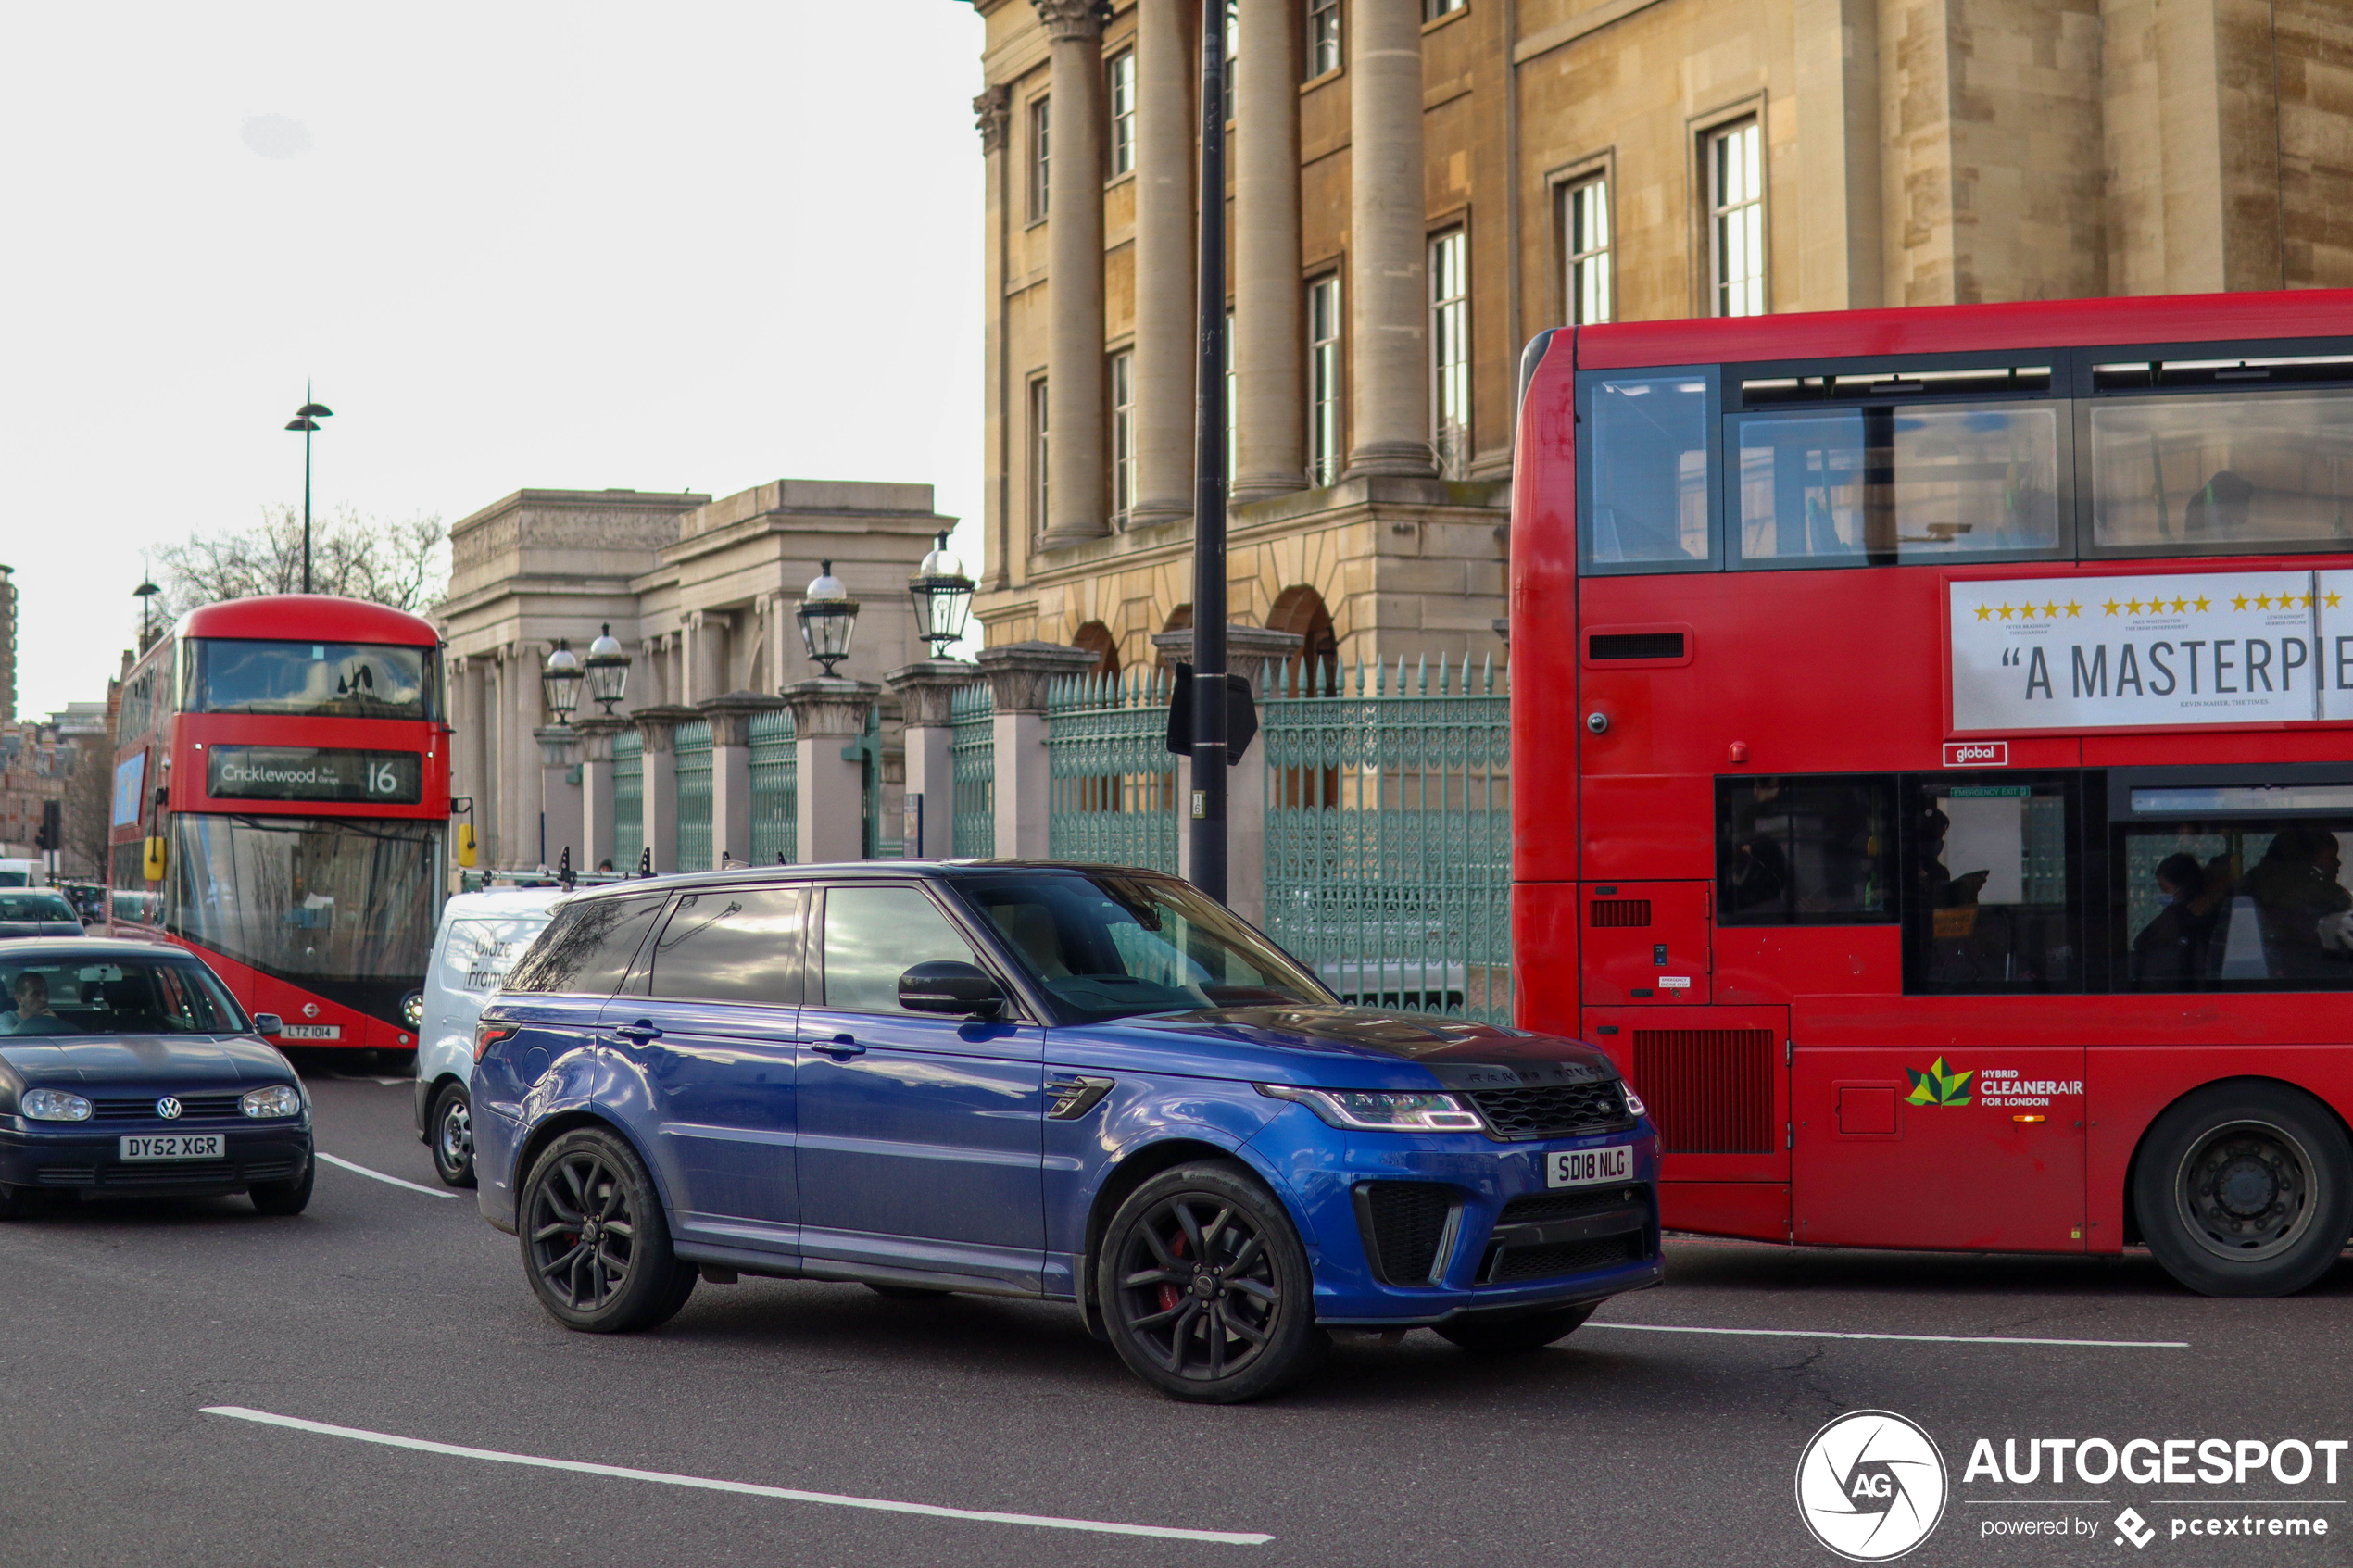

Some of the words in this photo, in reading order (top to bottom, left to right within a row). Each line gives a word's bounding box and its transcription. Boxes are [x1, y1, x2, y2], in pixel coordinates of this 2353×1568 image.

[1956, 746, 1994, 762] global
[221, 764, 316, 784] Cricklewood
[322, 767, 334, 775] Bus
[369, 761, 397, 794] 16
[475, 932, 513, 958] Glaze
[288, 1026, 308, 1036] LTZ
[311, 1026, 331, 1037] 1014
[1982, 1070, 2019, 1078] HYBRID
[1982, 1098, 2001, 1106] FOR
[2005, 1098, 2049, 1106] LONDON
[129, 1138, 176, 1156] DY52
[182, 1137, 216, 1154] XGR
[1559, 1154, 1595, 1181] SD18
[1600, 1150, 1624, 1177] NLG
